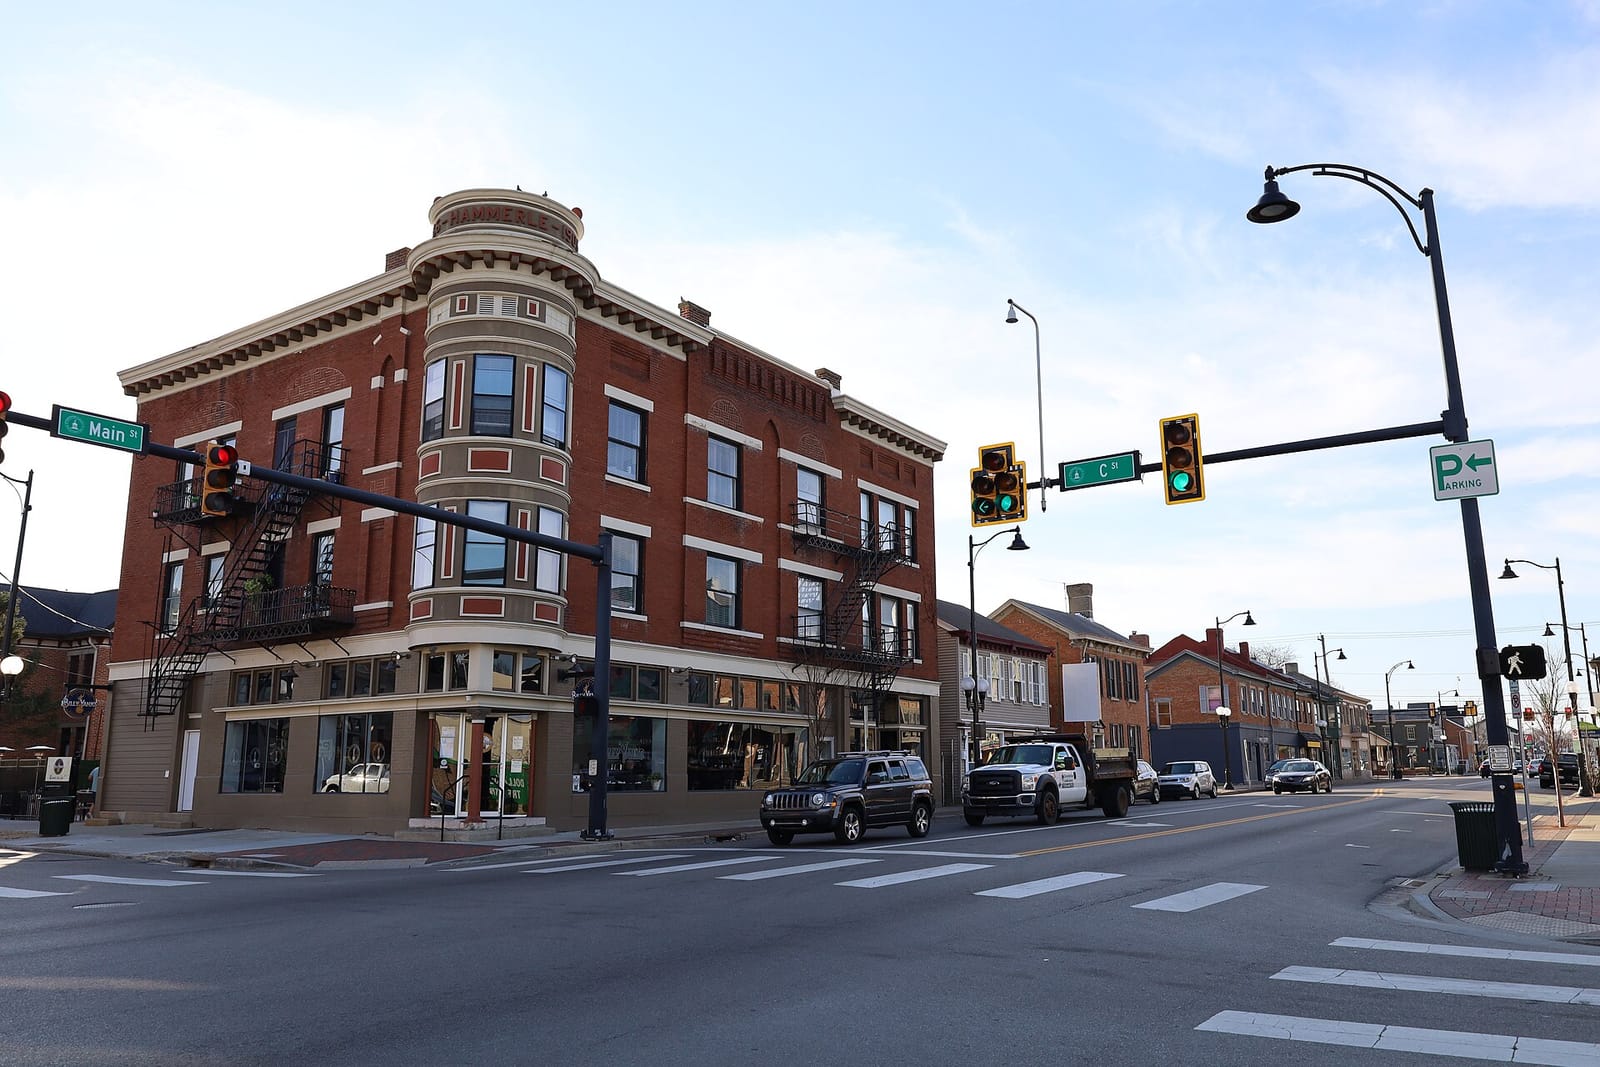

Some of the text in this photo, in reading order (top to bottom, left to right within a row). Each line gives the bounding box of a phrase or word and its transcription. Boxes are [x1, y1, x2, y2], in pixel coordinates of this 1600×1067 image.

[449, 205, 548, 231] HAMMERLE
[89, 420, 138, 442] Main St
[1099, 461, 1119, 478] C St
